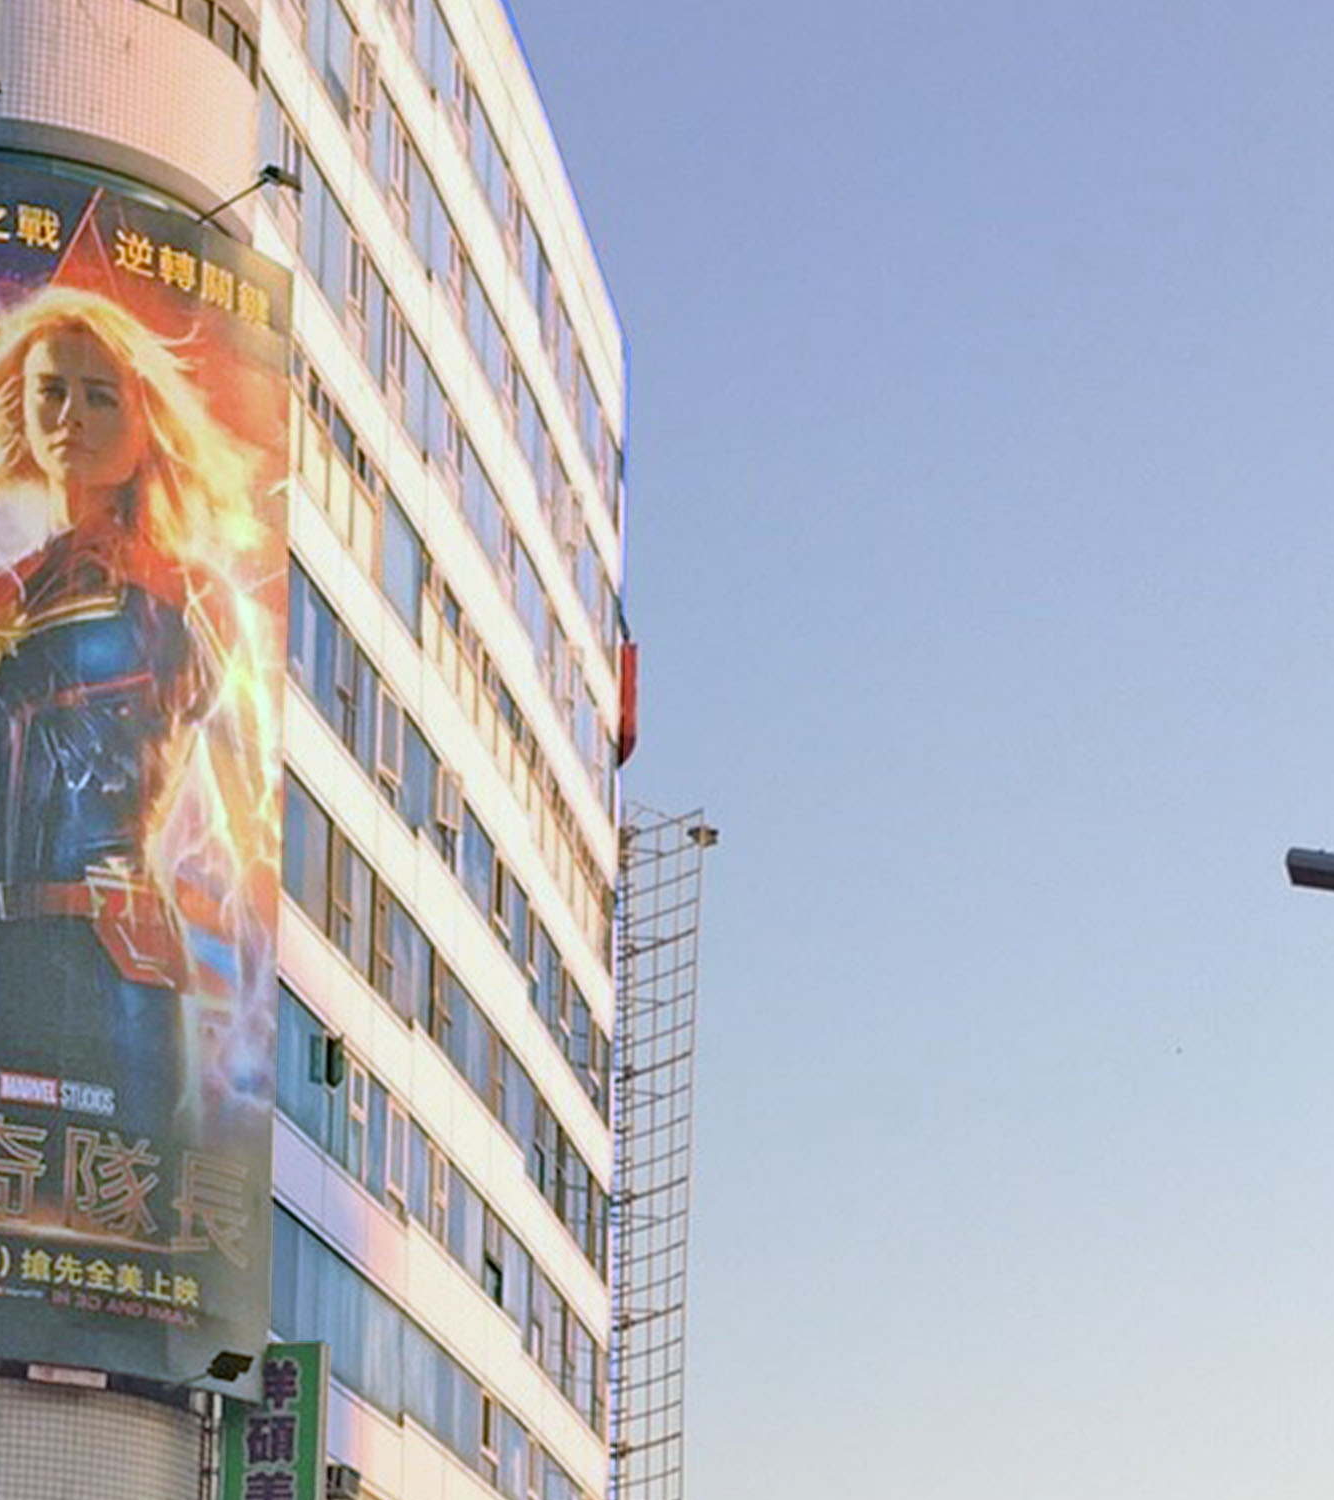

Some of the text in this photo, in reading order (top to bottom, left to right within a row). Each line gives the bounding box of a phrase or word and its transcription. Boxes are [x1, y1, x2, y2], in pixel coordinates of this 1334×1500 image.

[21, 1248, 200, 1307] 搶先全美上映
